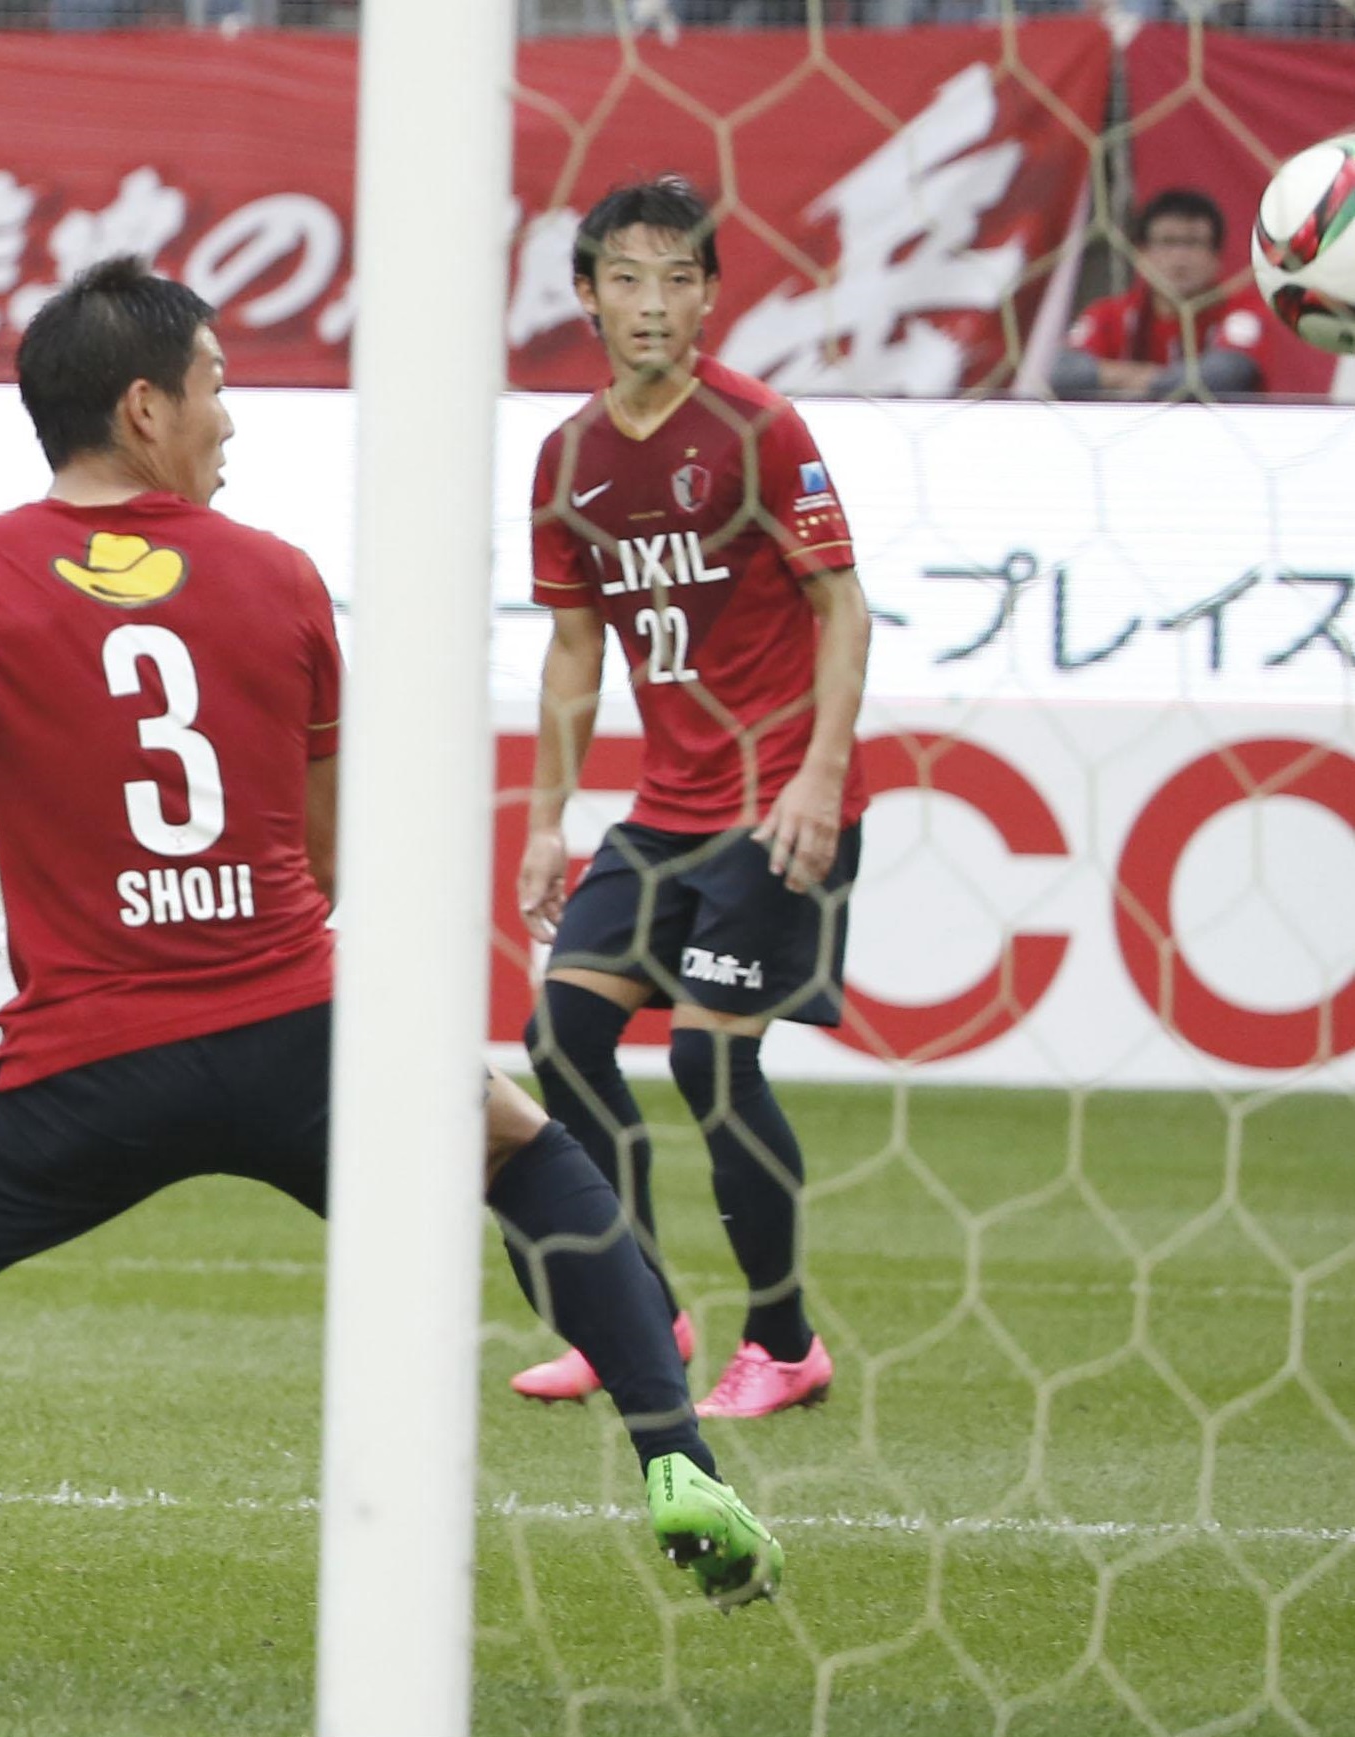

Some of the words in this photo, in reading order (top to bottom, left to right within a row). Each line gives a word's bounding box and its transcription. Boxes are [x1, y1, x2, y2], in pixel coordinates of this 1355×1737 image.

[590, 531, 730, 596] LIXIL
[635, 607, 699, 685] 22
[102, 623, 225, 857] 3
[116, 864, 255, 928] SHOJI
